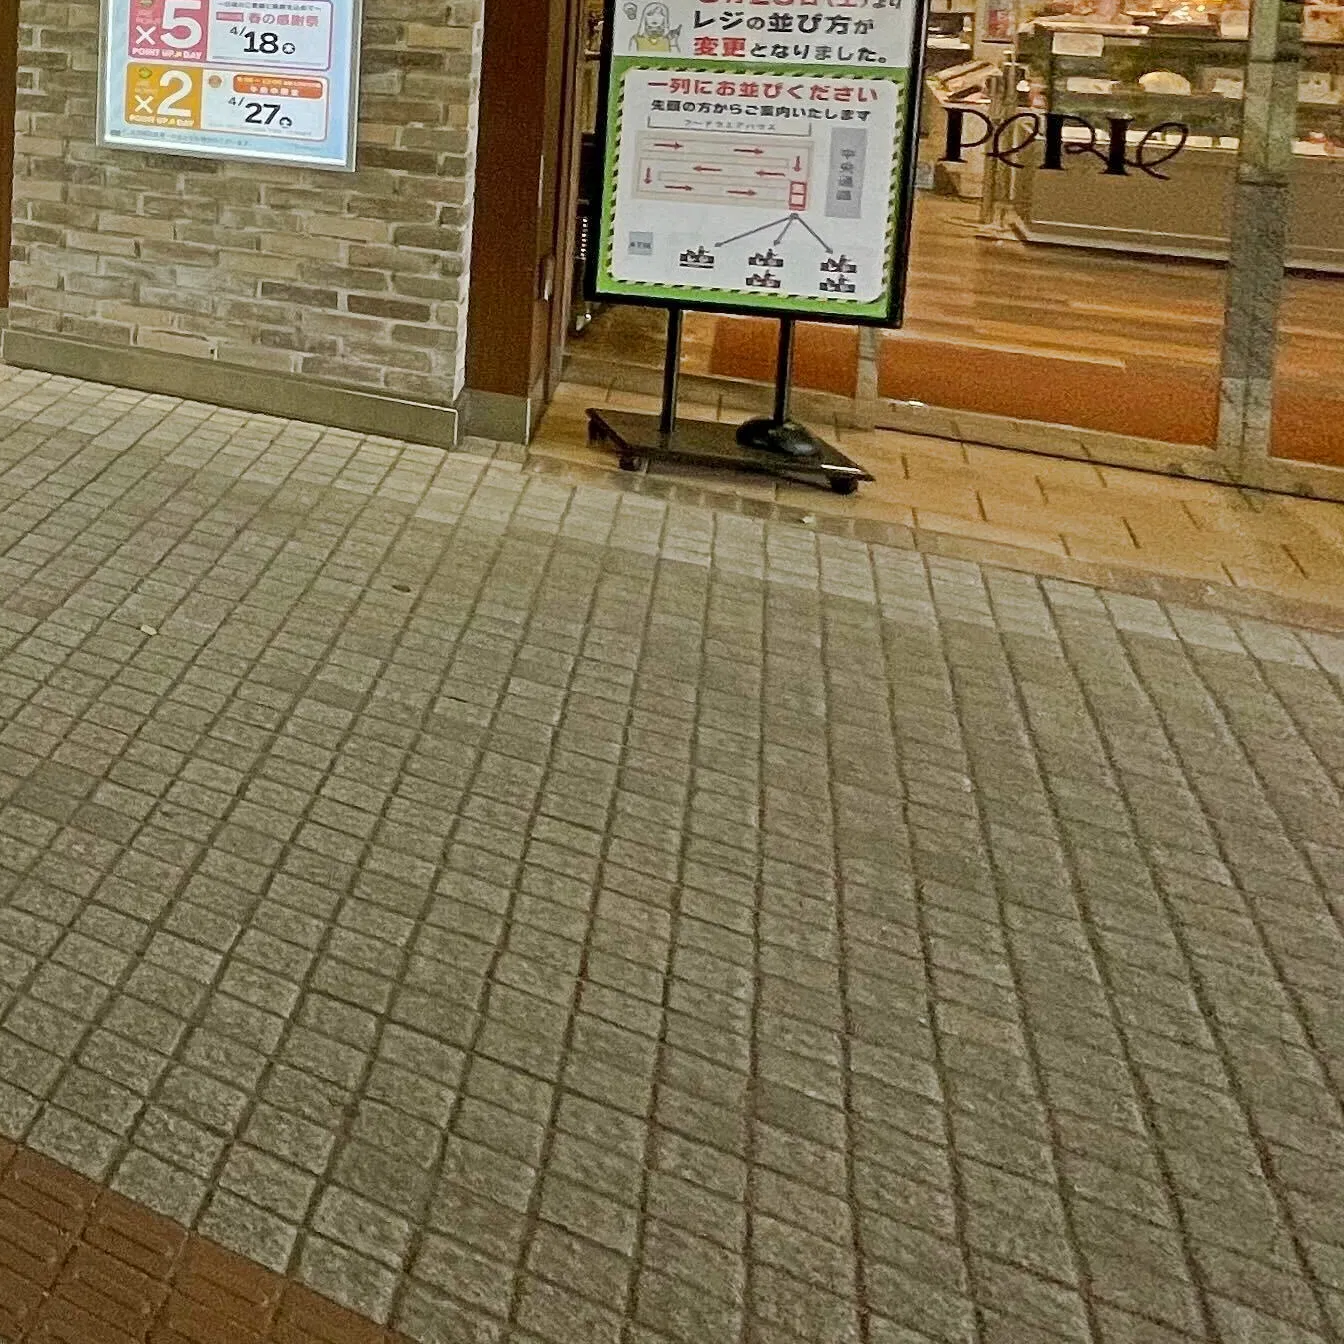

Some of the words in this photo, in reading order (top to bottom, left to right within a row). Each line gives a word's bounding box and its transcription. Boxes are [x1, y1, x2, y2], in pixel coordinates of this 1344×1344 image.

[693, 10, 875, 35] レジの並び方が
[648, 77, 879, 103] 一列にお並びください
